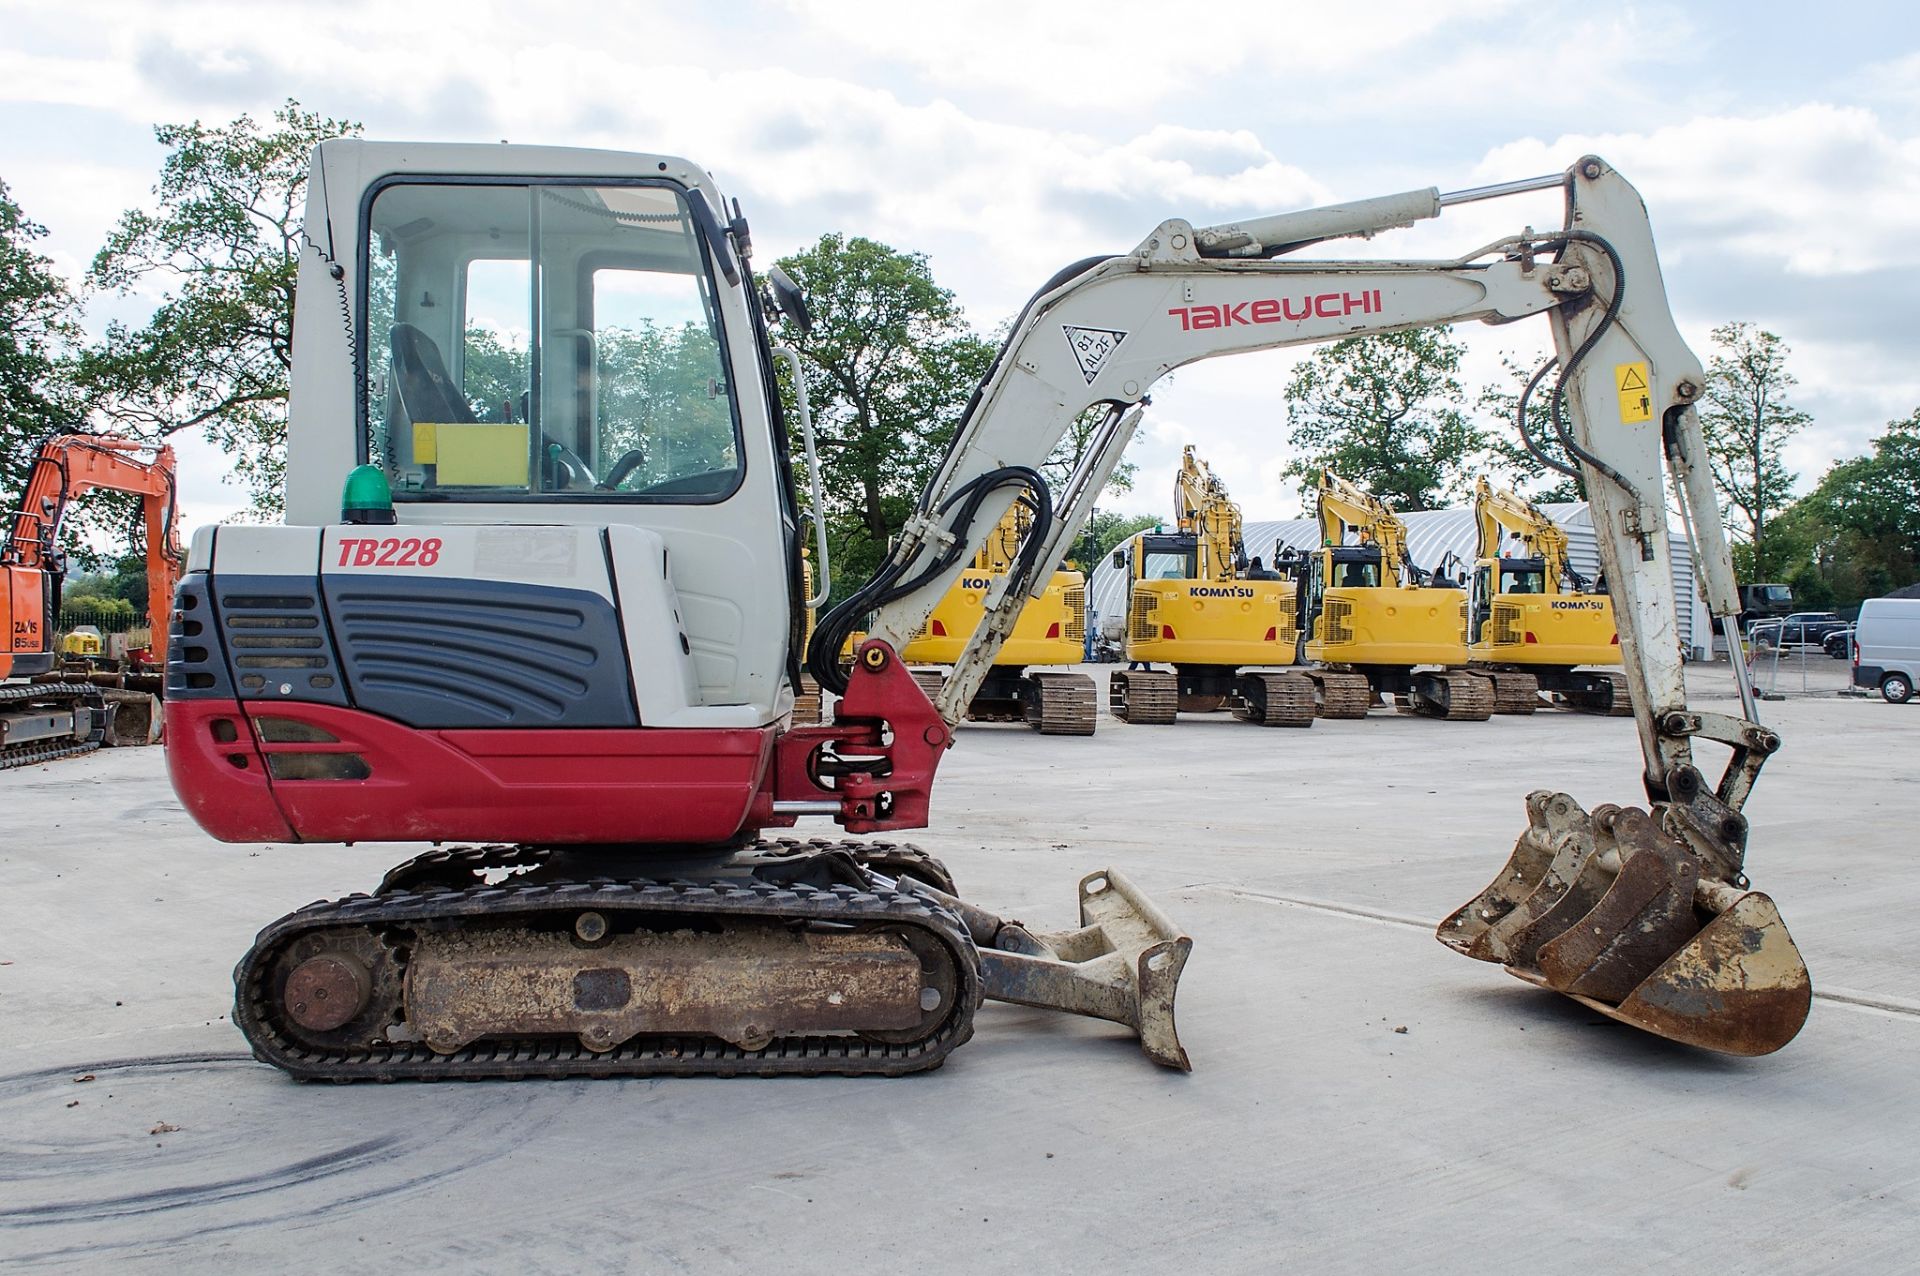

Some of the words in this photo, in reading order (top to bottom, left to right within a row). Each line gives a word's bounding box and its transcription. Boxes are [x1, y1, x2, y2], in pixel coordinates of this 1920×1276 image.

[1077, 335, 1094, 352] 81
[1085, 335, 1110, 369] AL2F
[338, 538, 443, 567] TB228
[1190, 586, 1254, 598] KOMATSU
[1551, 600, 1604, 610] KOMATSU
